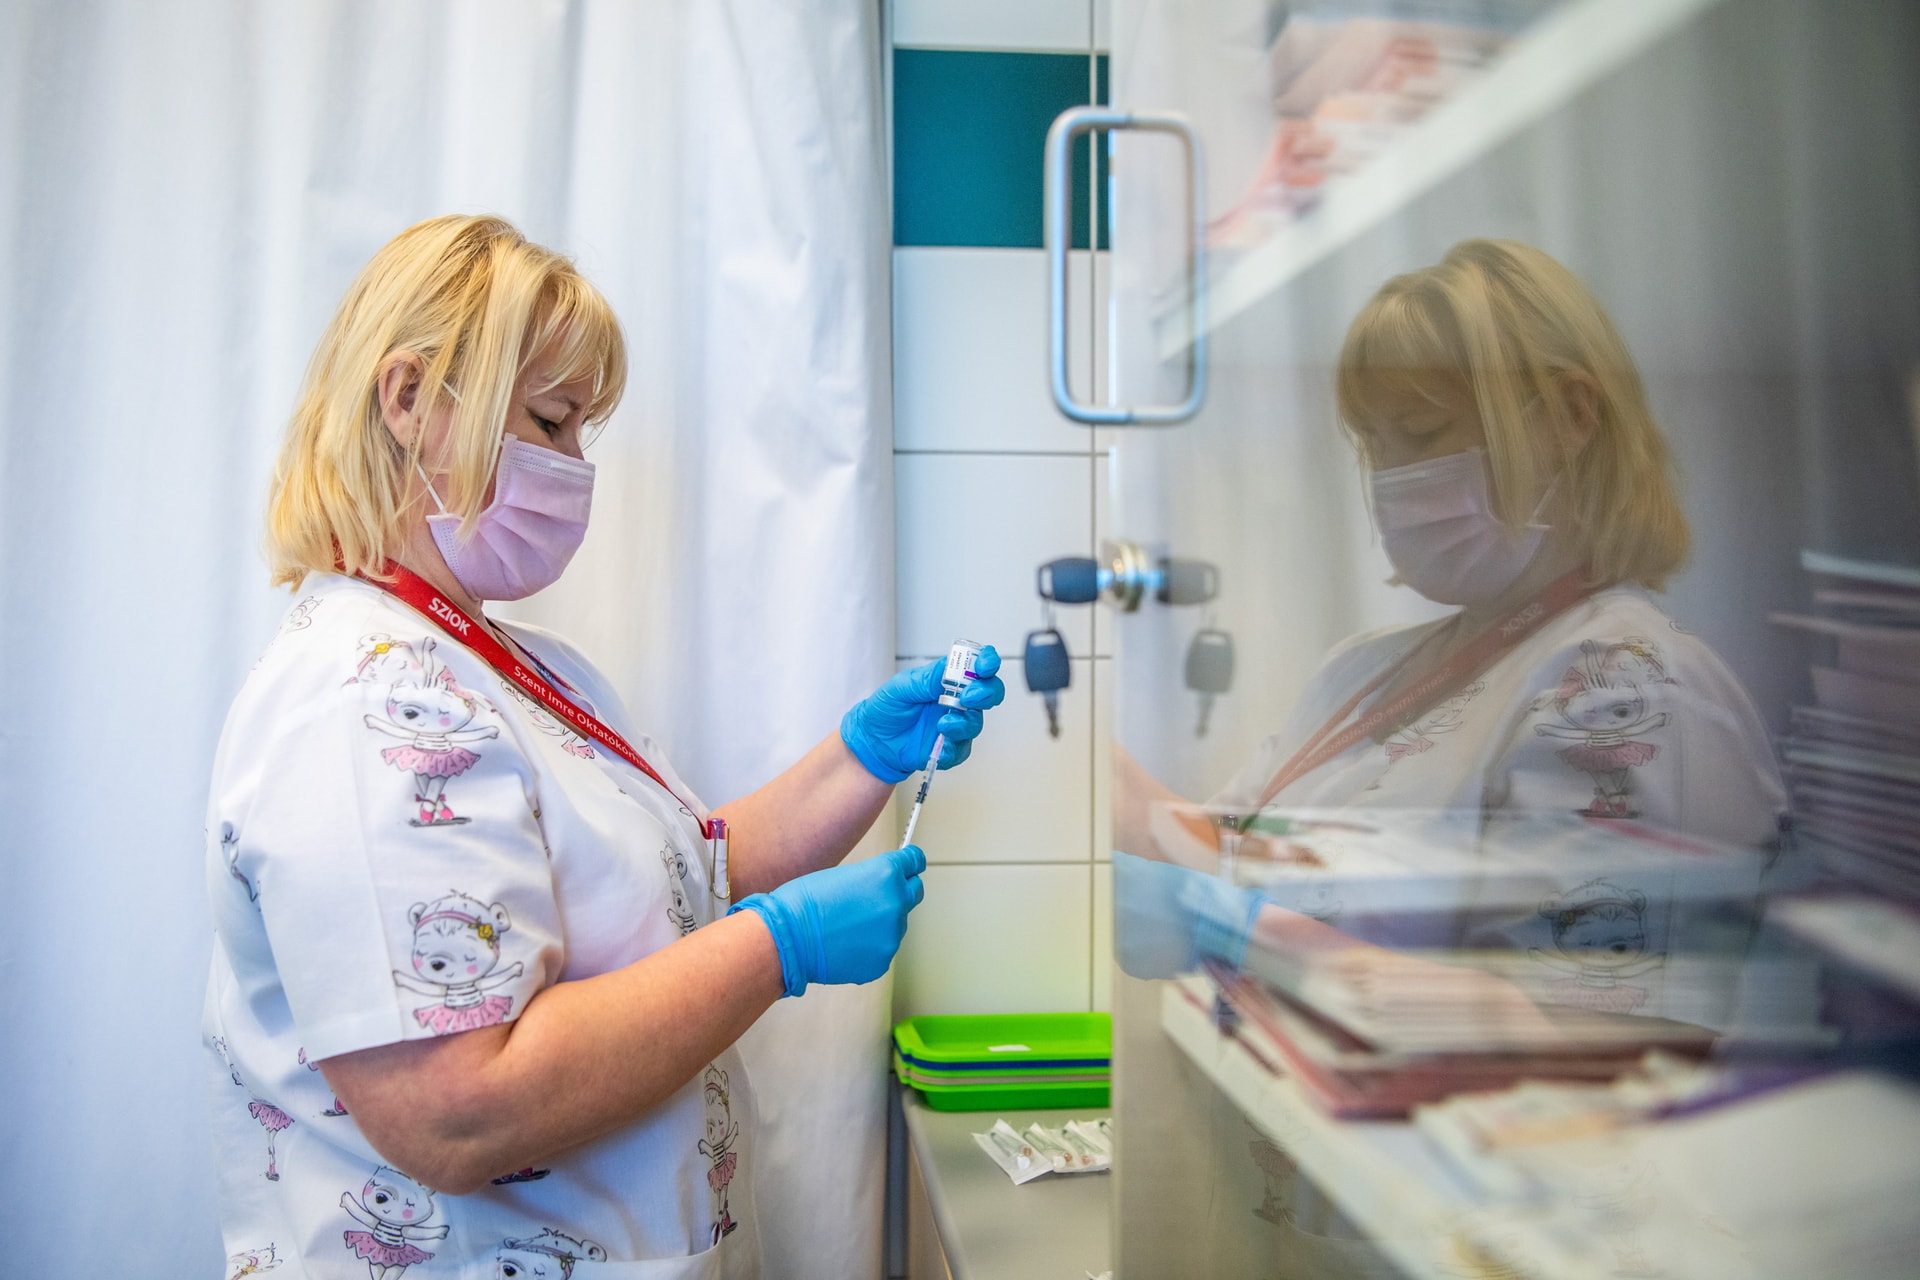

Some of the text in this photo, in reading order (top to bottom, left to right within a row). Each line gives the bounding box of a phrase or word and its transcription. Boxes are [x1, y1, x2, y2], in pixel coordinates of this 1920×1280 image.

[428, 597, 471, 637] SZIOK
[514, 665, 546, 697] Szent
[548, 691, 575, 717] Imre
